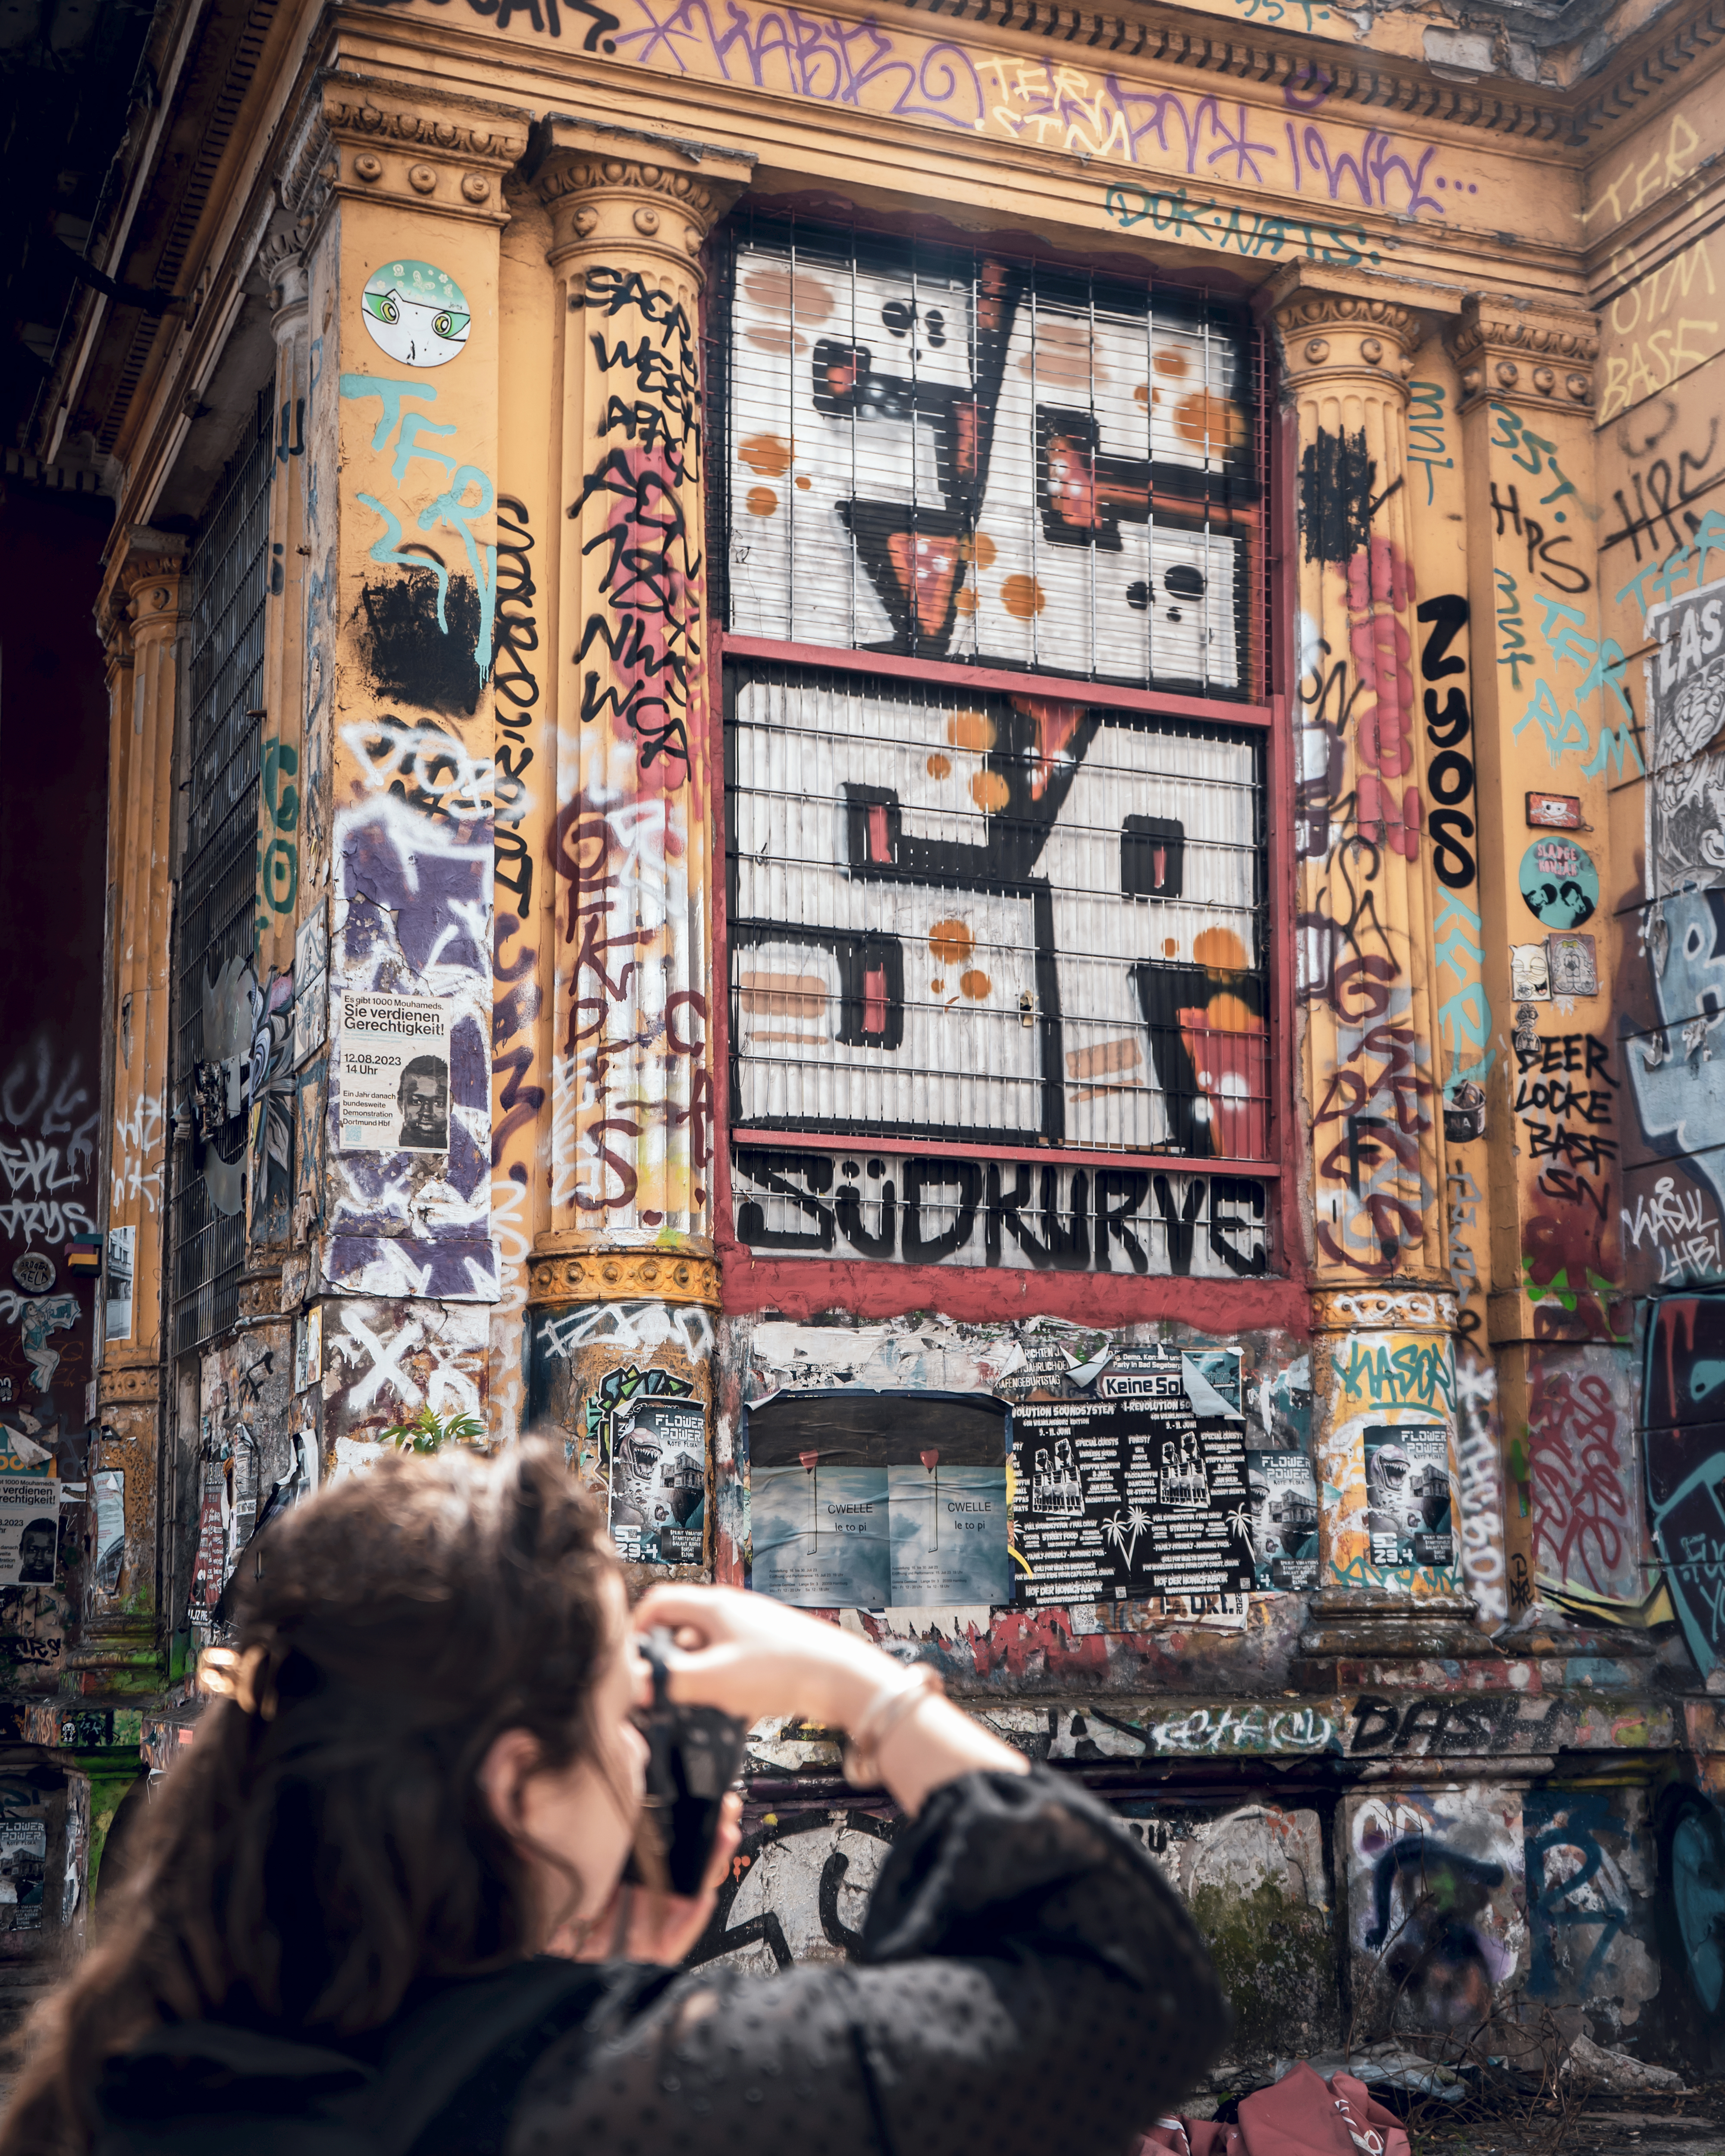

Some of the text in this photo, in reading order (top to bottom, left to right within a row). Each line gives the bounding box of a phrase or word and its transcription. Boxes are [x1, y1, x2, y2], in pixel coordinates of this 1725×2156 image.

[356, 997, 370, 1005] gibt
[373, 998, 392, 1006] 1000
[394, 1000, 444, 1009] Mouhameds.
[345, 1004, 439, 1022] Sie verdienen
[345, 1017, 444, 1035] Gerechtigkeit!
[344, 1054, 401, 1065] 12.08.2023
[360, 1065, 378, 1075] Uhr
[343, 1109, 392, 1117] Demonstration
[1152, 1361, 1182, 1370] Segeberg
[1107, 1378, 1152, 1395] Keine
[655, 1413, 704, 1430] FLOWER
[660, 1427, 701, 1442] POWER
[1402, 1430, 1447, 1442] FLOWER
[1407, 1442, 1445, 1454] POWER
[1262, 1456, 1311, 1468] FLOWER
[1267, 1468, 1310, 1479] POWER
[3, 1486, 52, 1495] verdienen
[828, 1504, 873, 1514] CWELLE
[948, 1502, 991, 1512] CWELLE
[835, 1523, 843, 1531] le
[859, 1523, 866, 1533] pi
[955, 1521, 962, 1529] le
[978, 1520, 985, 1531] pi
[1190, 1523, 1204, 1531] FOOD
[1063, 1531, 1078, 1540] FOOD
[1154, 1575, 1167, 1587] HOF
[1168, 1574, 1182, 1585] DER
[1026, 1585, 1039, 1597] HOF
[1040, 1584, 1054, 1595] DER
[0, 1822, 44, 1831] FLOWER
[1, 1832, 41, 1840] POWER
